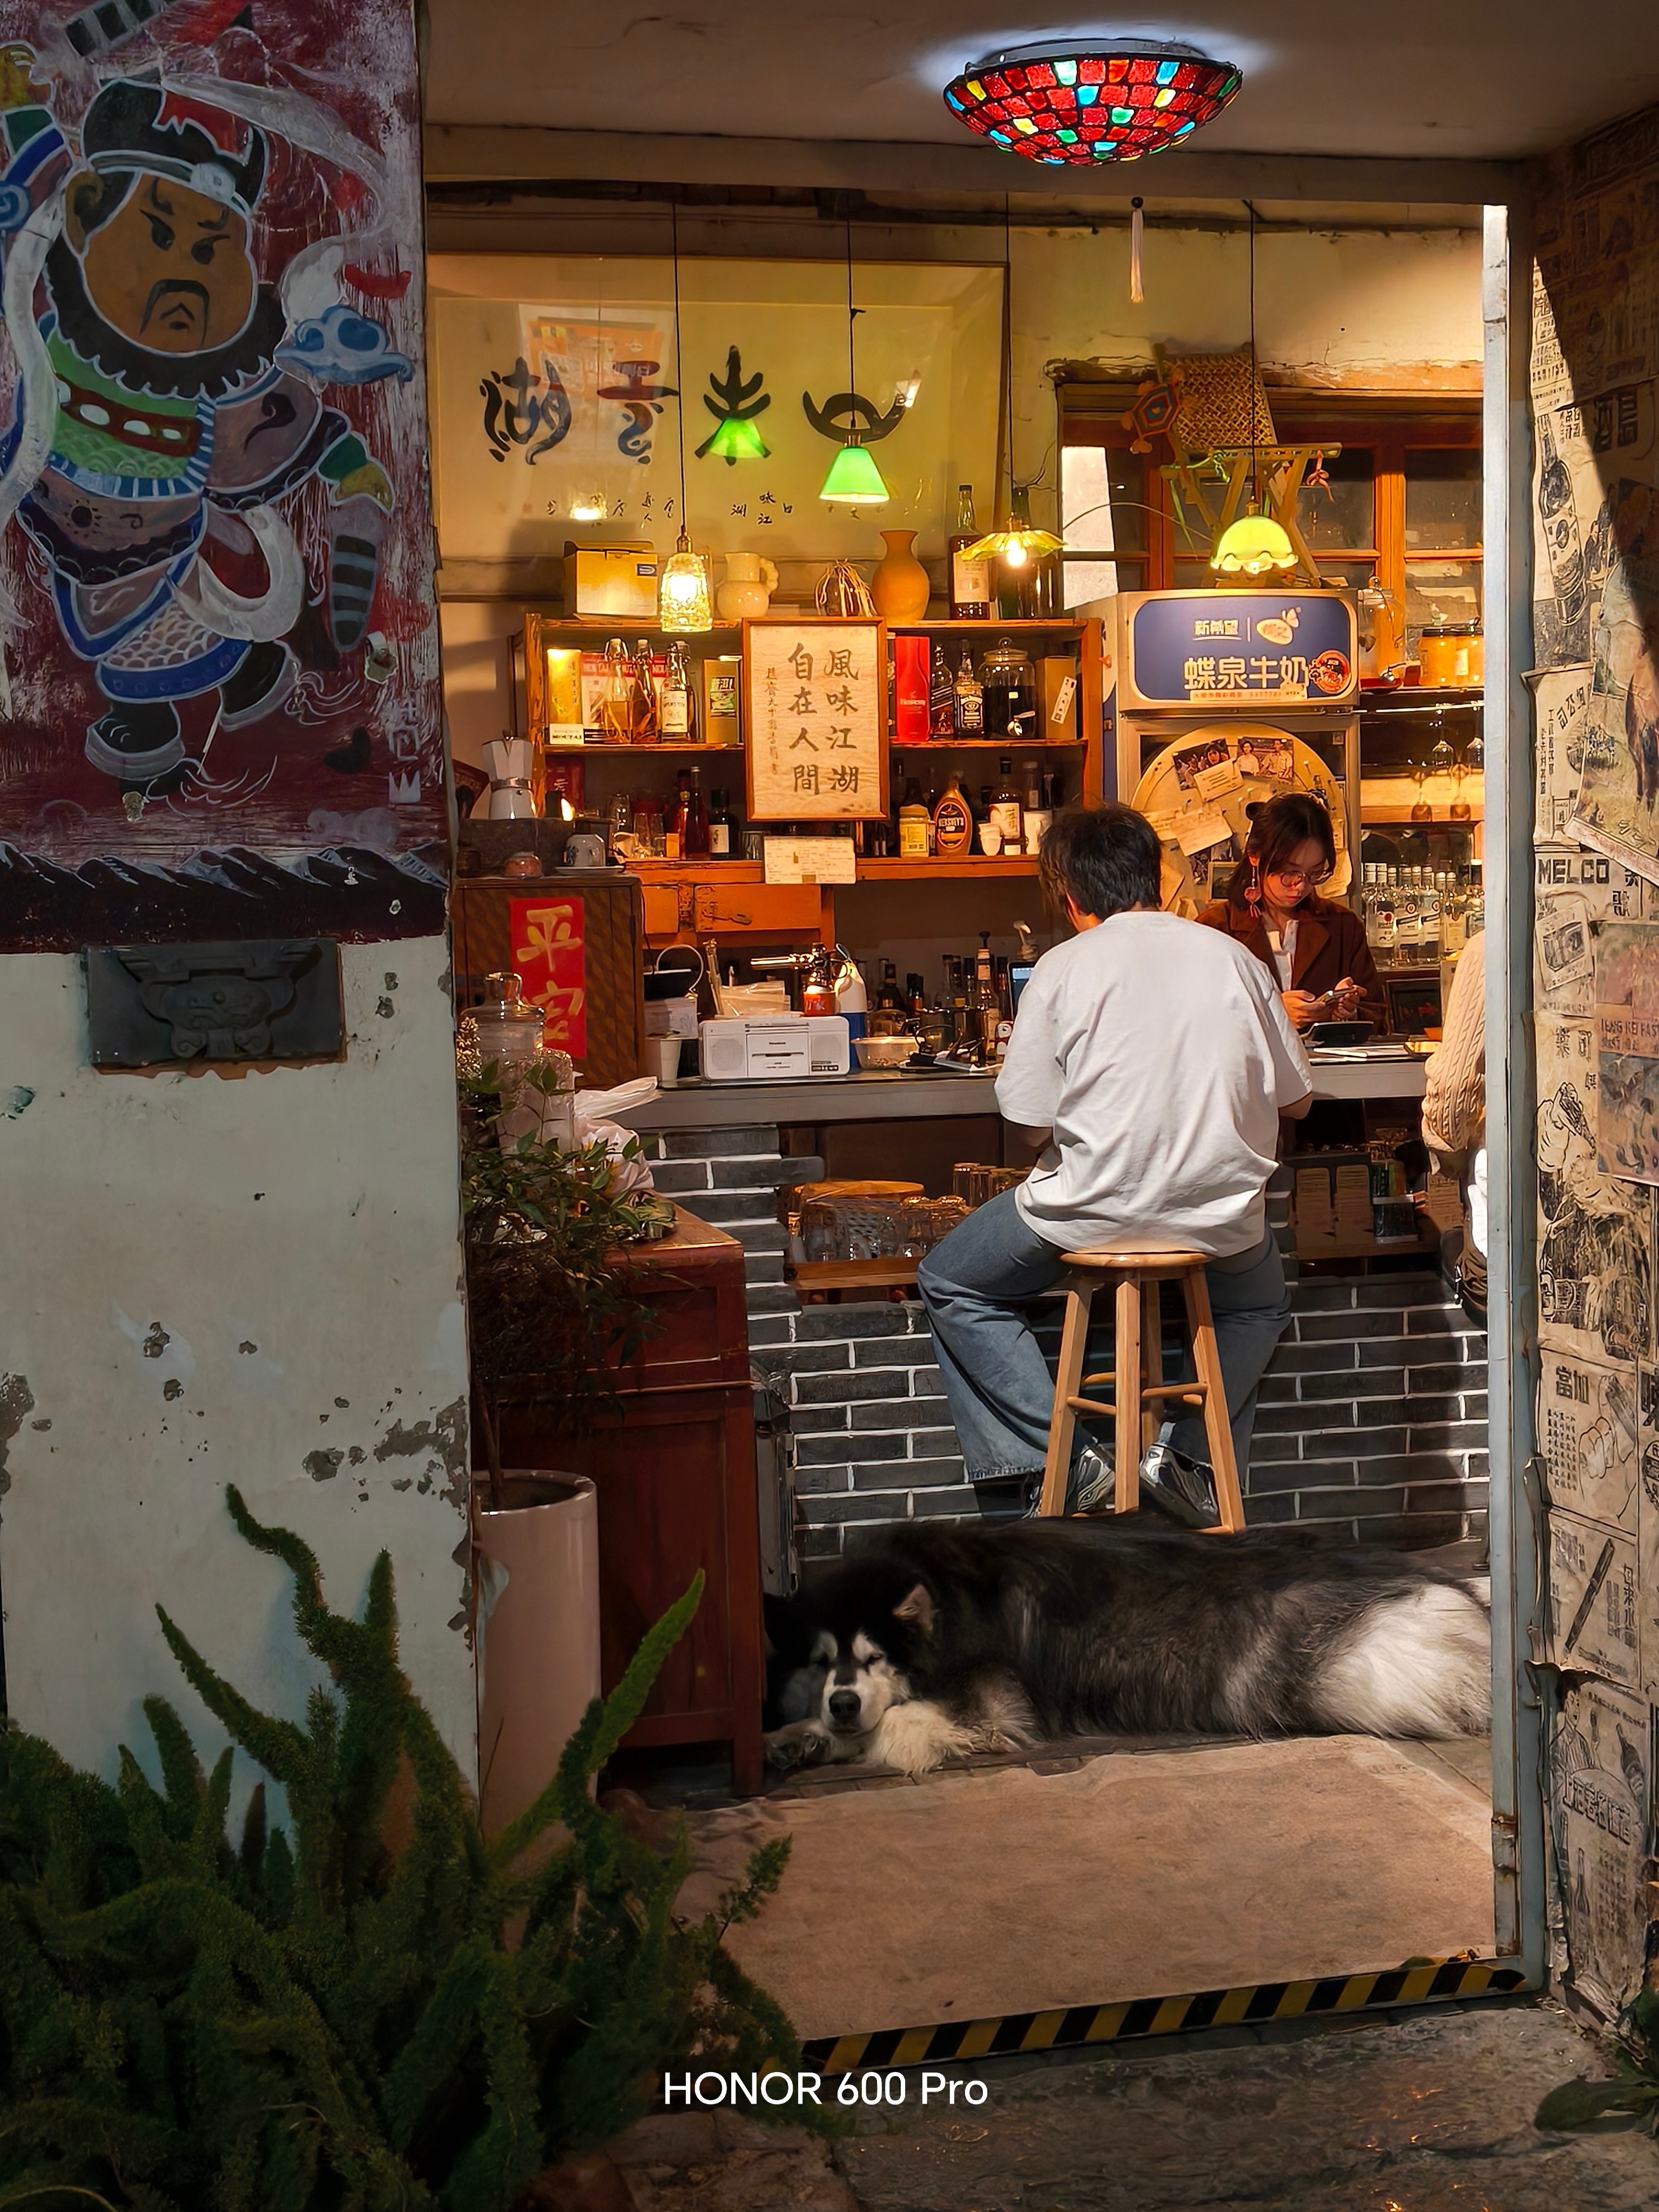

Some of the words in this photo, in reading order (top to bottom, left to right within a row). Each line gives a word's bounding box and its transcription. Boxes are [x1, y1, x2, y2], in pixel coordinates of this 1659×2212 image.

[787, 642, 820, 795] 自在人間
[824, 649, 860, 794] 風味江湖
[1183, 656, 1310, 690] 蝶泉牛奶
